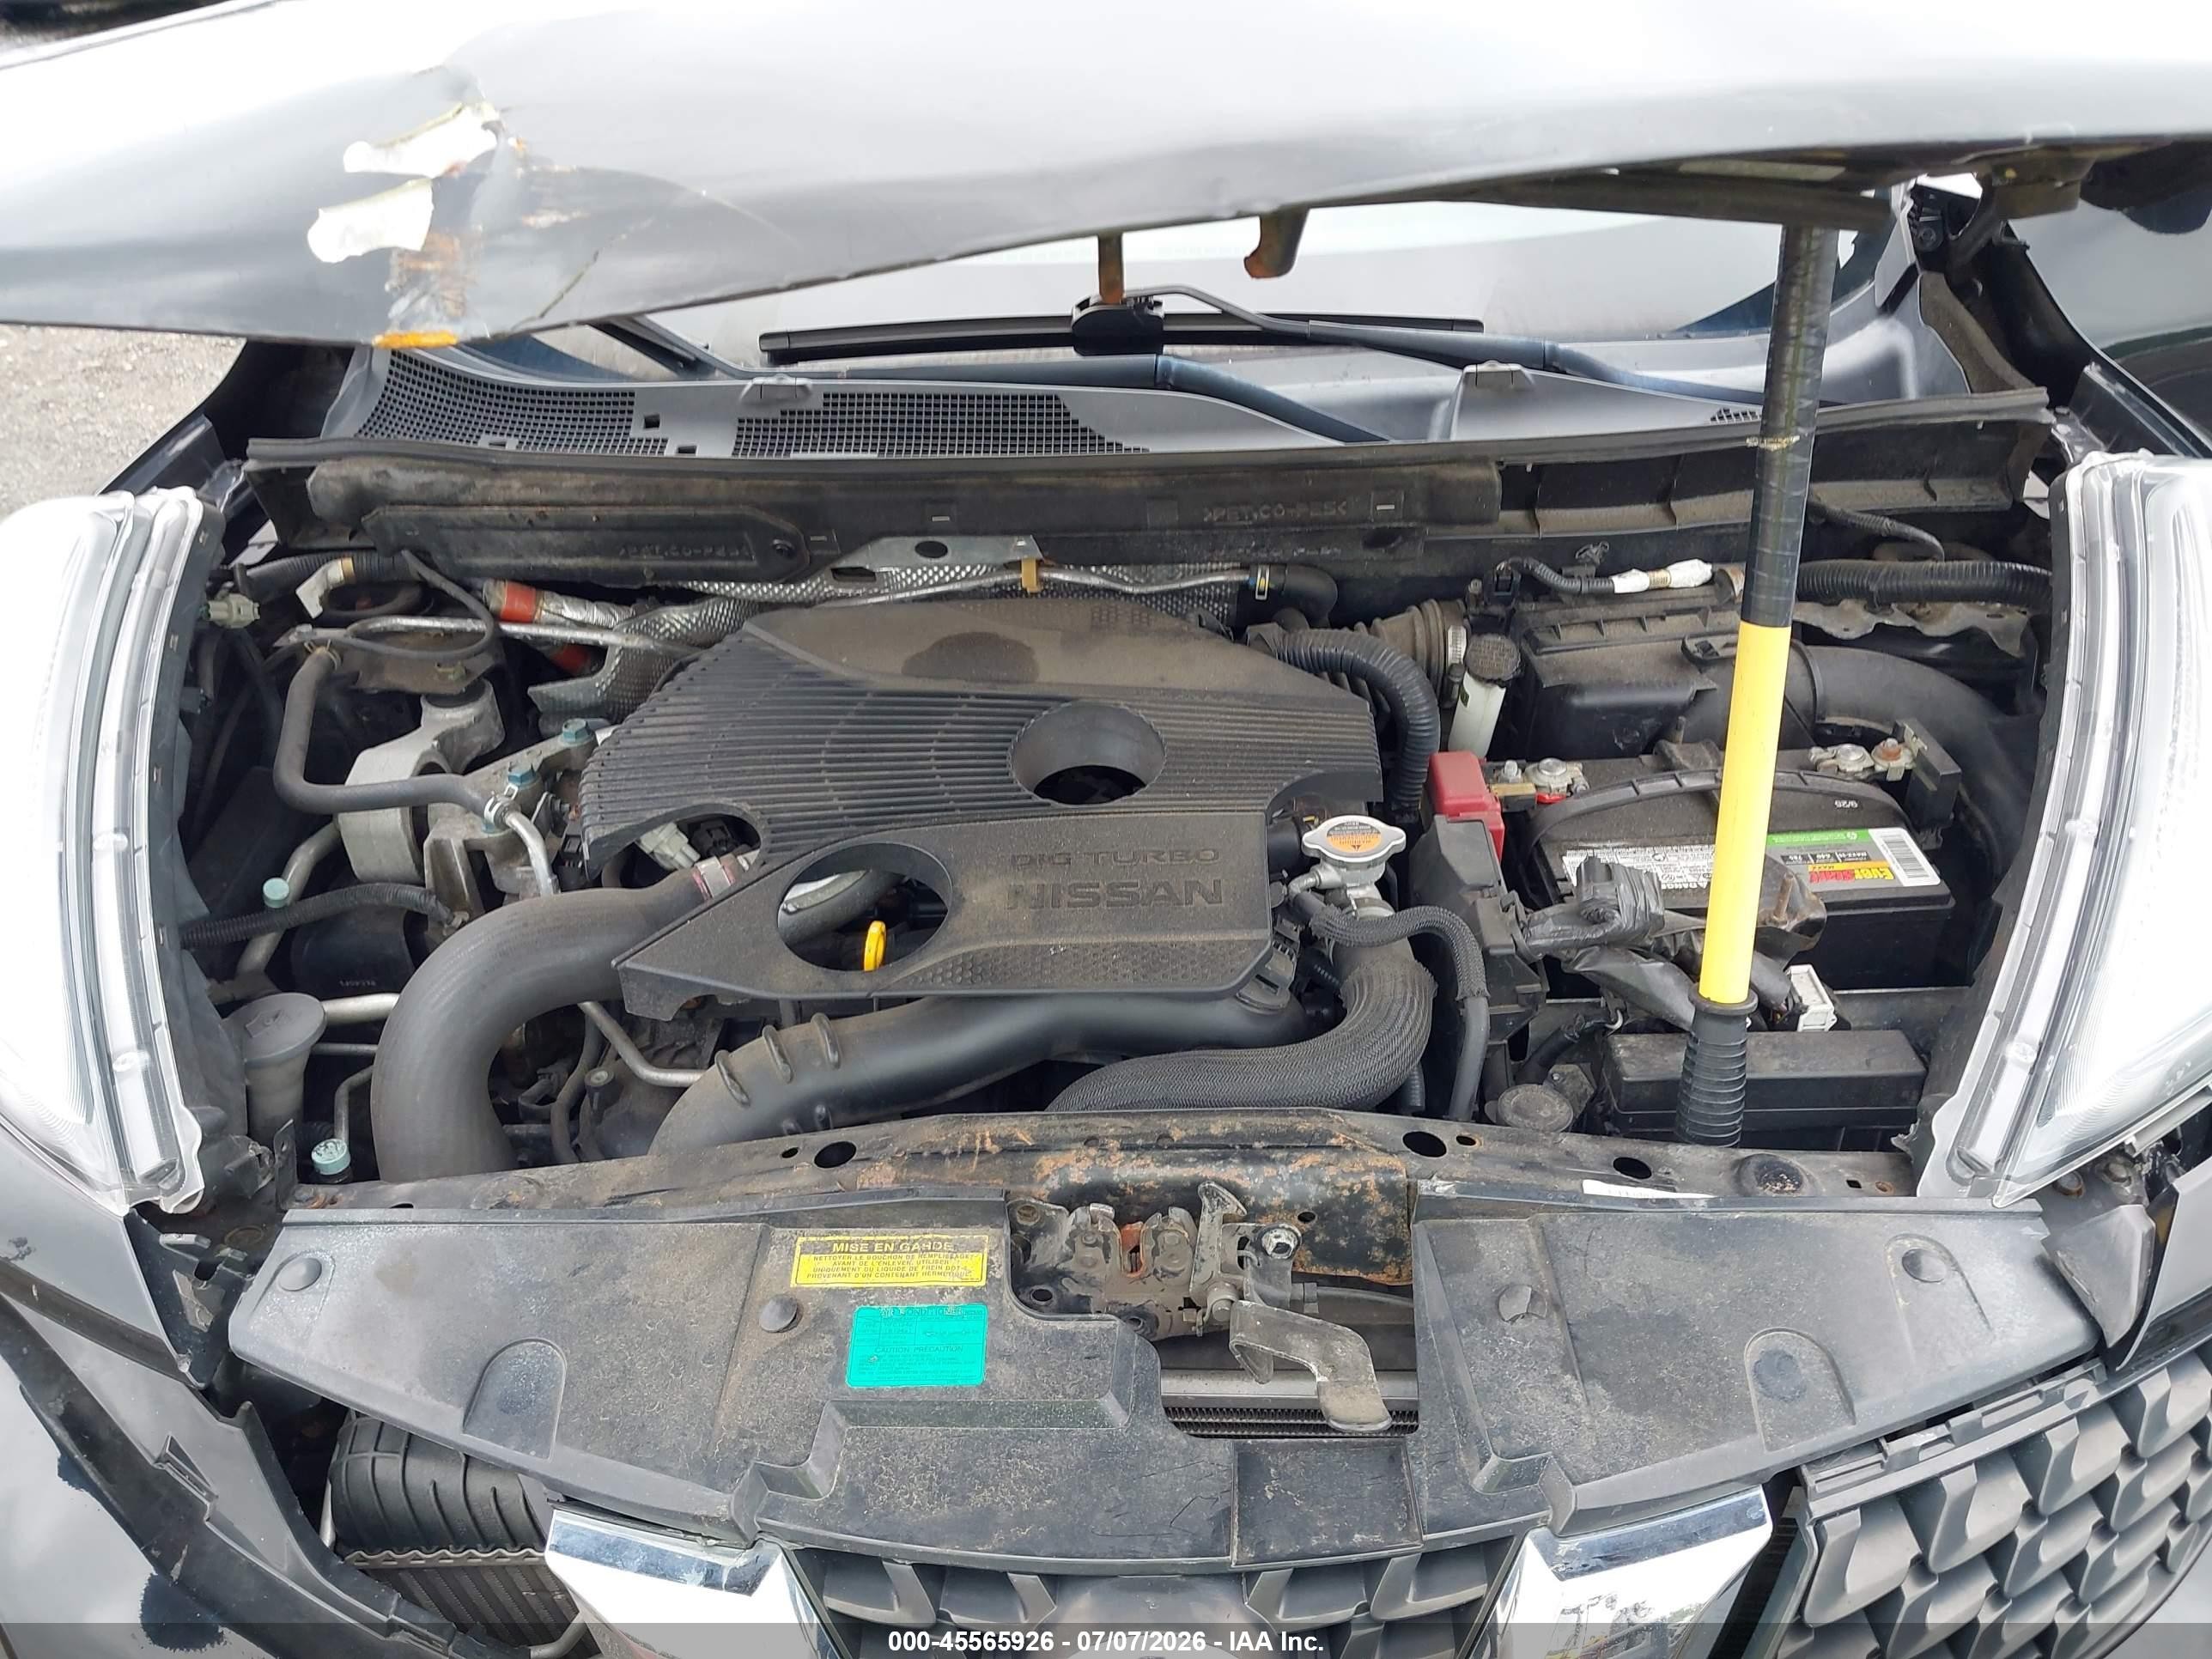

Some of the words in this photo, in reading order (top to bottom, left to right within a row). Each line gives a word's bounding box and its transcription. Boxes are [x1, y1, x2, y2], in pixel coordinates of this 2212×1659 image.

[1084, 848, 1219, 866] TURBO
[1007, 879, 1223, 910] NISSAN
[833, 1243, 869, 1252] MISE
[874, 1243, 895, 1252] EN
[900, 1242, 954, 1252] GARDE
[874, 1346, 910, 1354] CAUTION
